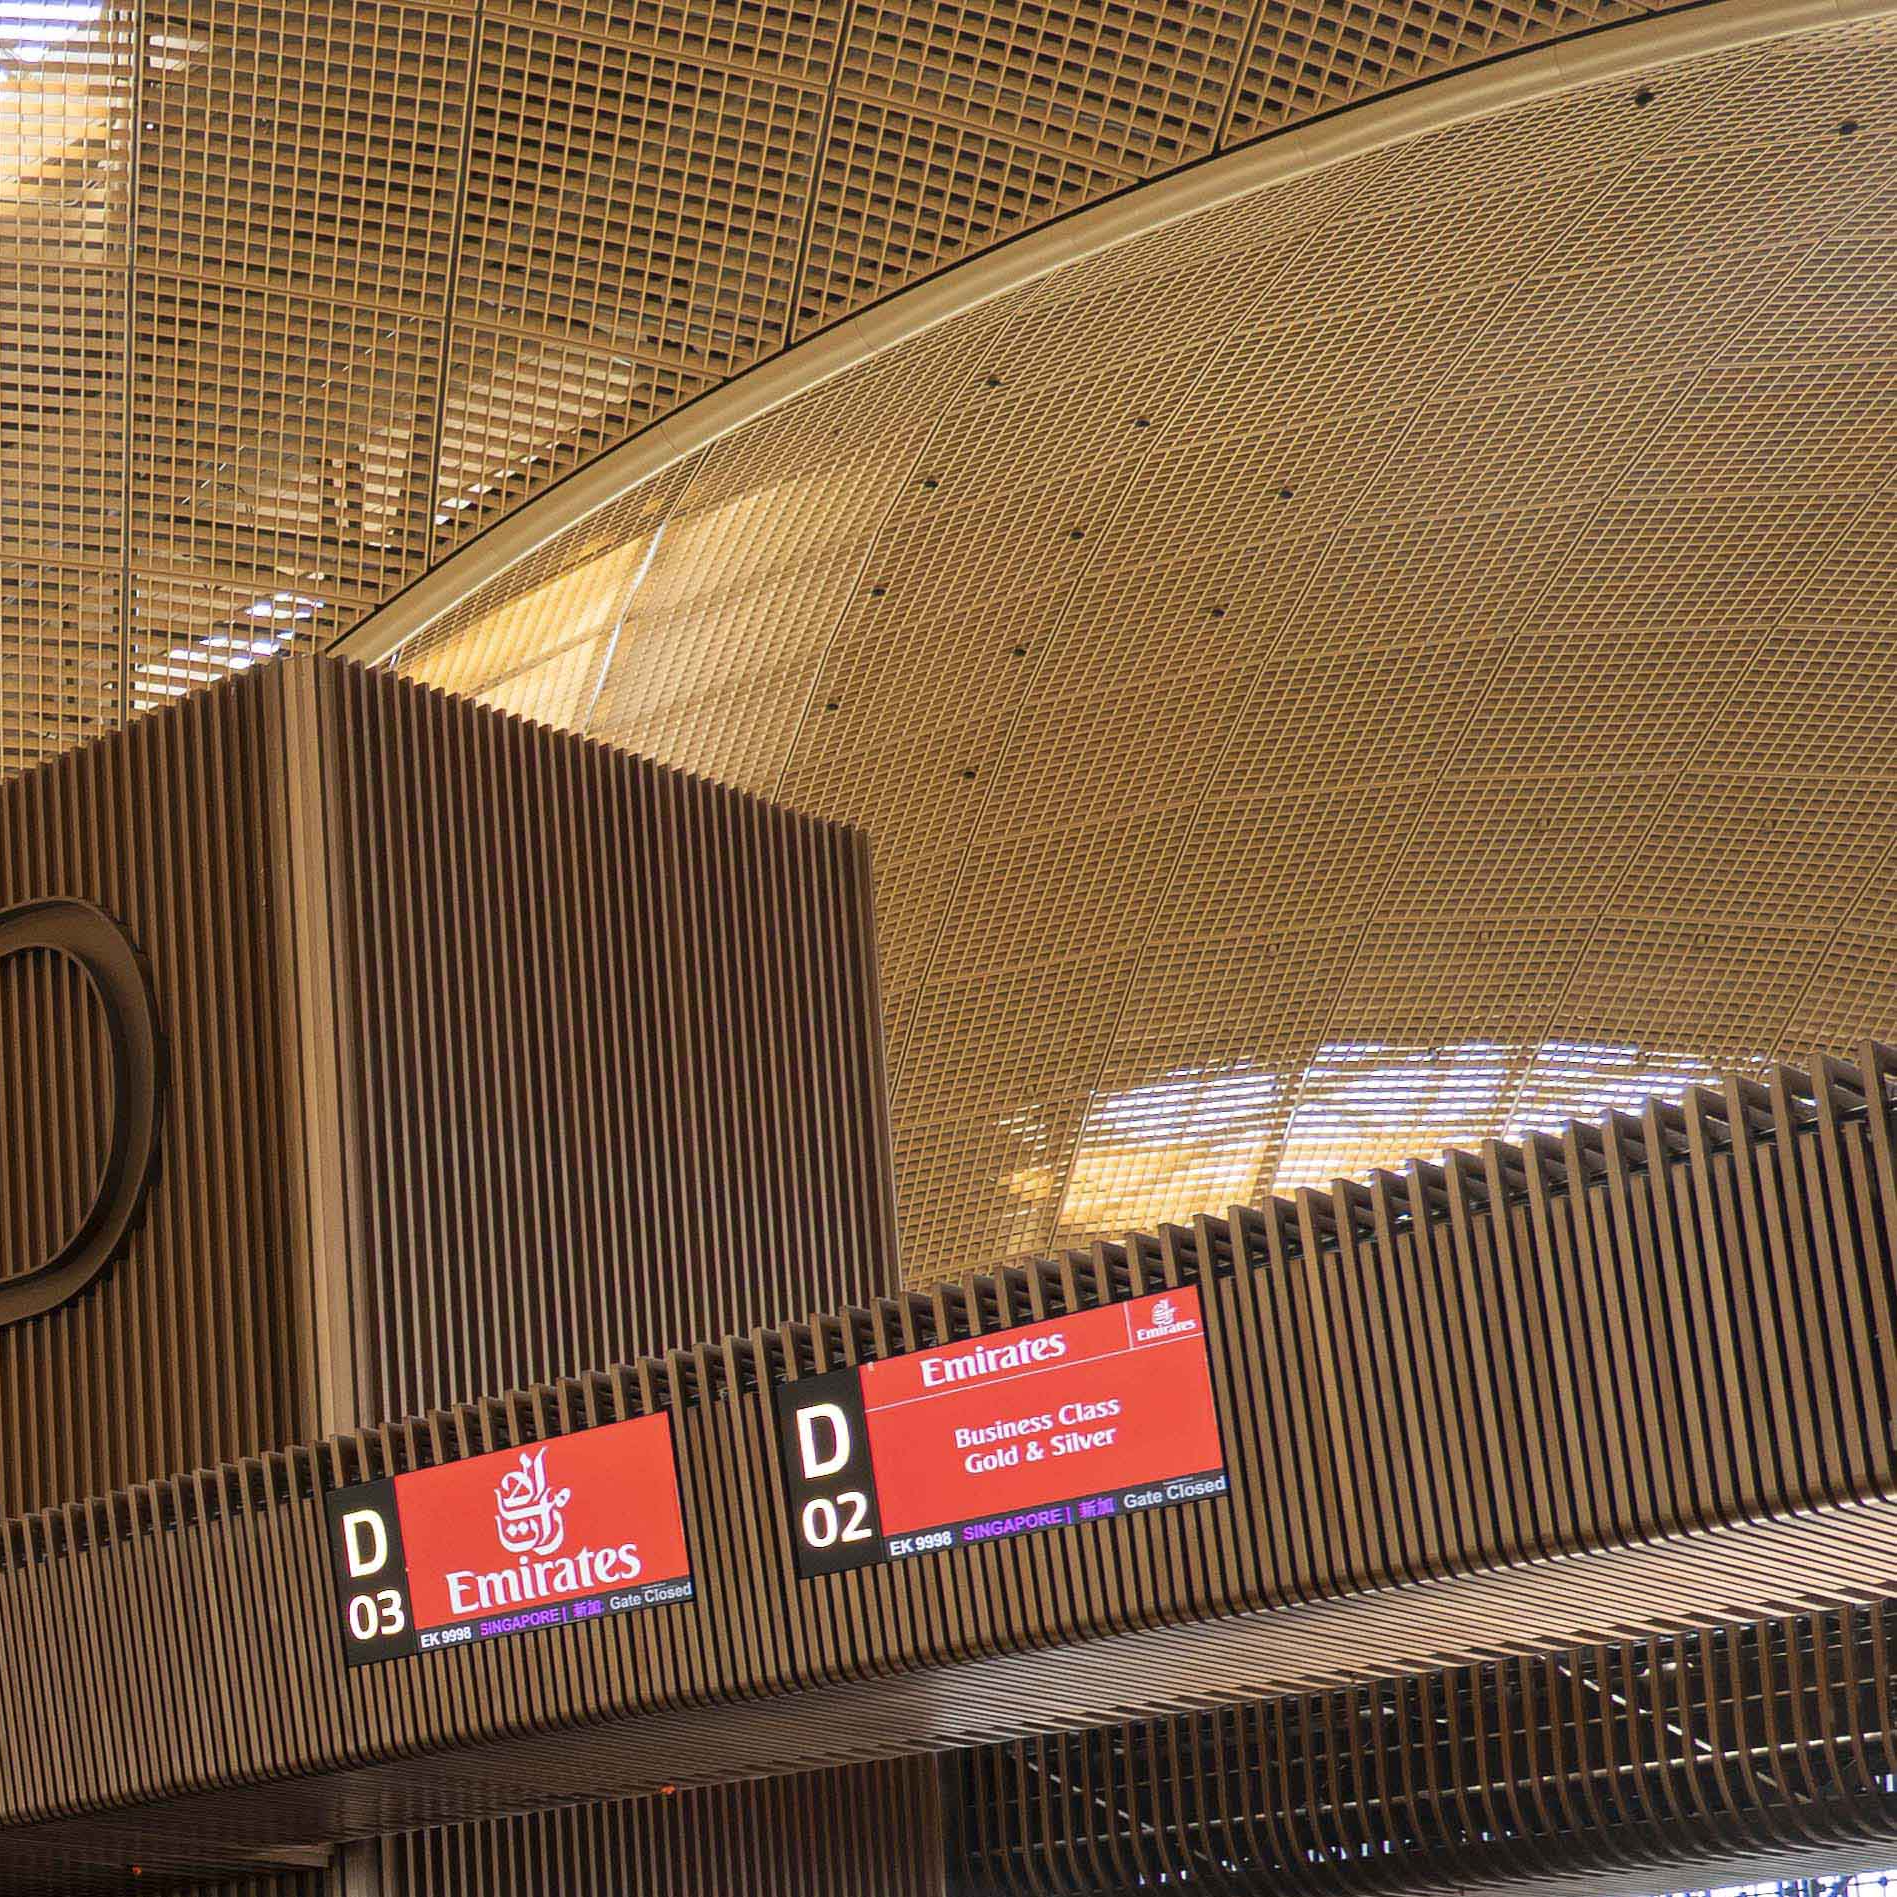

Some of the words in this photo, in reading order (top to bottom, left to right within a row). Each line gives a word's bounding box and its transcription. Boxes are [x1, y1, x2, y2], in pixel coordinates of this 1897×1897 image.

[1136, 1319, 1196, 1342] Emirates
[920, 1333, 1067, 1387] Emirates
[796, 1403, 851, 1479] D
[955, 1414, 1054, 1448] Business
[1058, 1398, 1120, 1426] Class
[964, 1447, 1019, 1474] Gold
[1026, 1440, 1045, 1461] &
[1051, 1426, 1116, 1458] Silver
[1124, 1490, 1163, 1509] Gate
[1166, 1475, 1226, 1501] Closed
[343, 1509, 388, 1578] D
[802, 1491, 872, 1548] 02
[889, 1538, 914, 1557] EK
[916, 1531, 952, 1553] 9998
[963, 1509, 1062, 1541] SINGAPORE
[446, 1543, 641, 1615] Emirates
[610, 1592, 642, 1611] Gate
[644, 1582, 692, 1604] Closed
[348, 1589, 405, 1640] 03
[420, 1631, 441, 1649] EK
[441, 1626, 472, 1645] 9998
[480, 1608, 559, 1636] SINGAPORE
